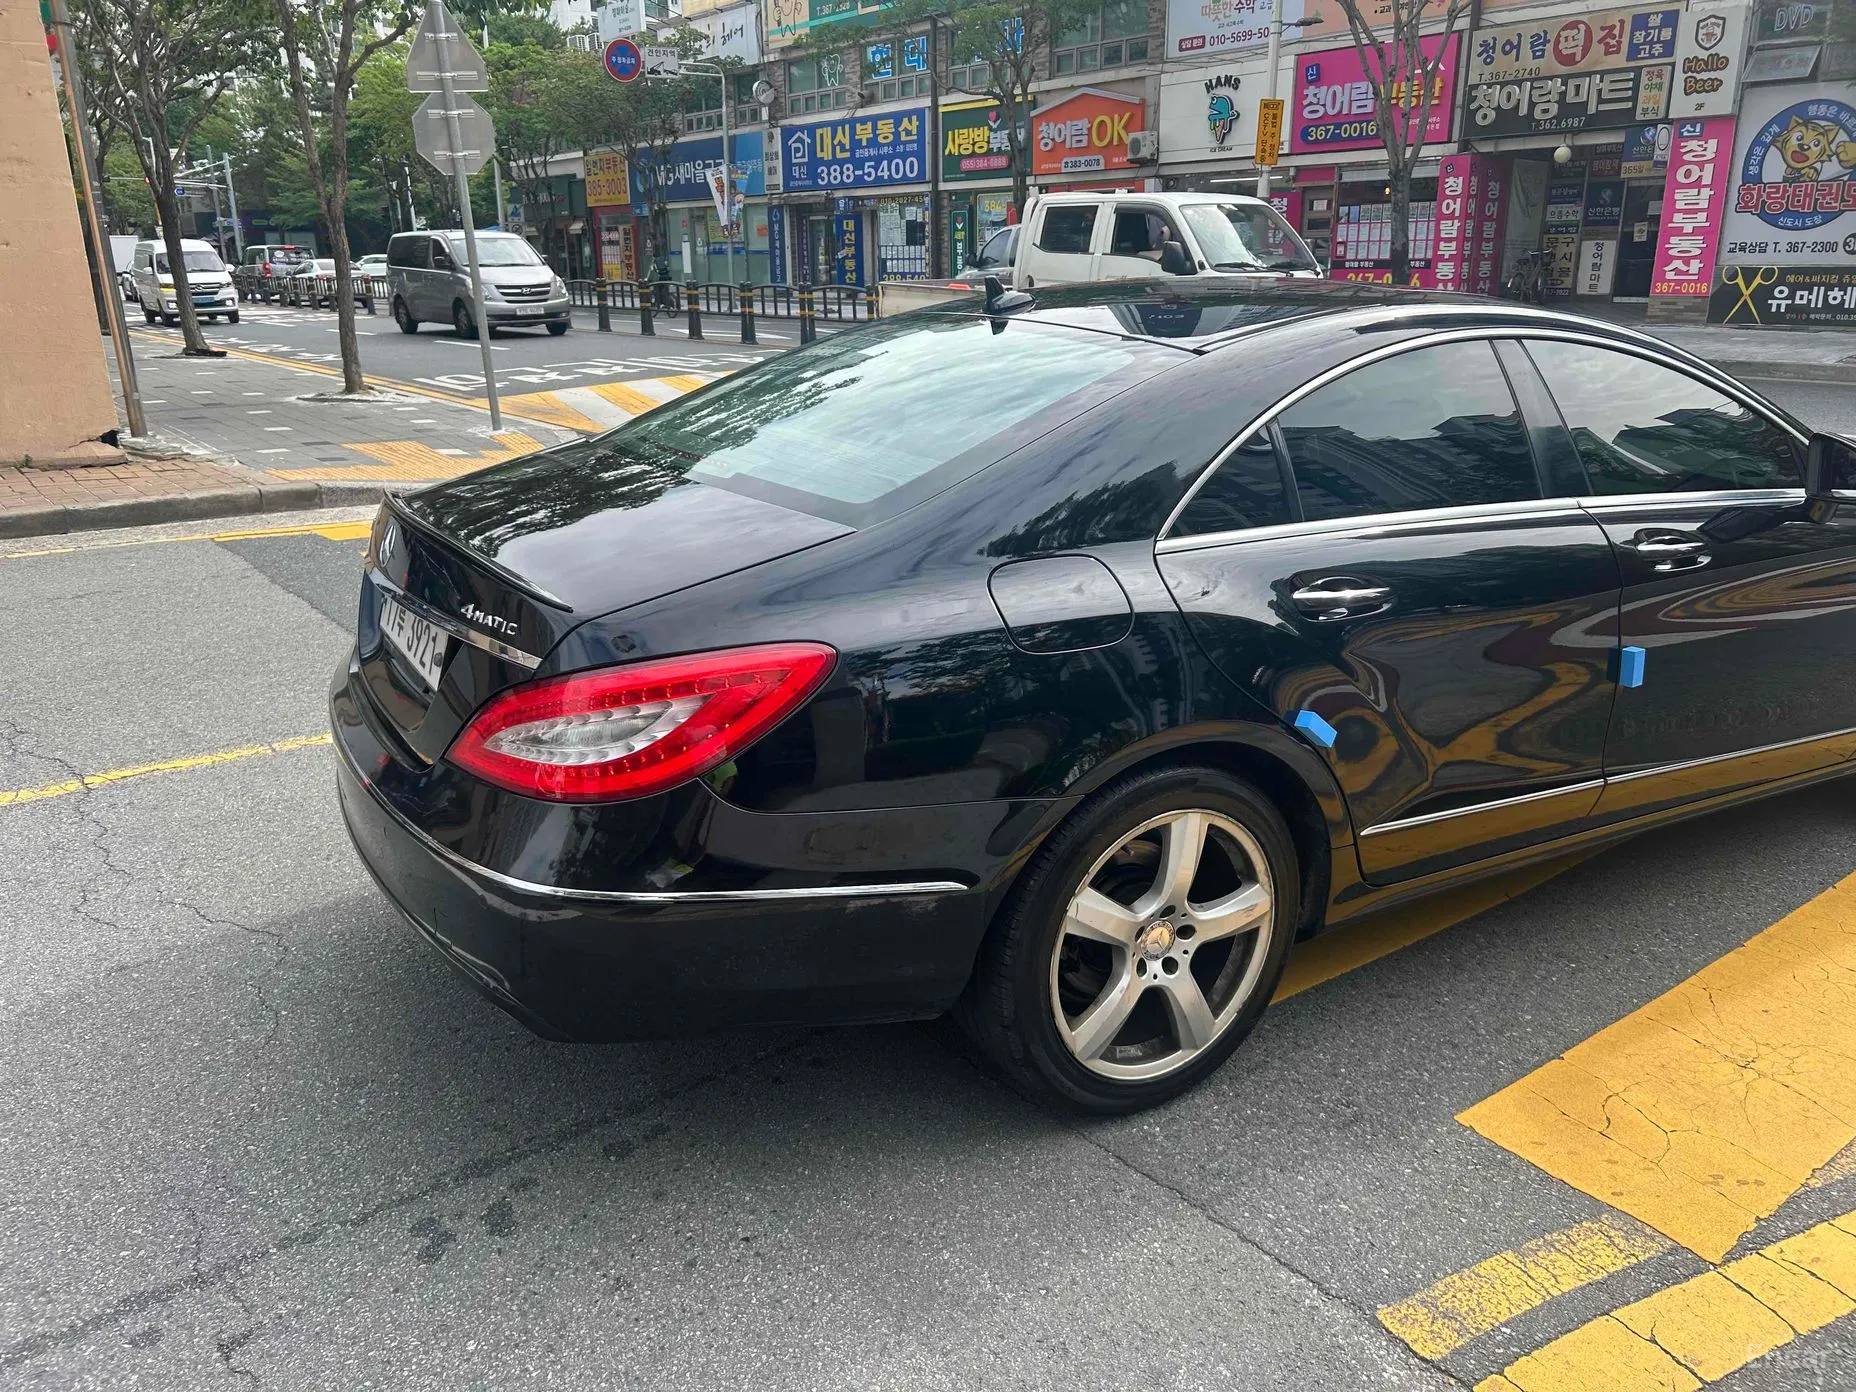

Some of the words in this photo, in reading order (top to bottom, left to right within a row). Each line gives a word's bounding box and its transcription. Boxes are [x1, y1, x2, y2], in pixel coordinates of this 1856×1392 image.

[1234, 0, 1256, 14] 수학
[1647, 13, 1664, 27] 쌀
[1774, 4, 1814, 32] DVD
[1209, 26, 1270, 47] 010-5699-50
[1632, 27, 1673, 43] 참기름
[647, 49, 676, 59] 견인지역
[1637, 44, 1664, 59] 고추
[1682, 52, 1729, 75] Hallo
[1307, 66, 1317, 80] 신
[1478, 66, 1541, 83] T.367-2740
[1645, 68, 1665, 81] 정육
[1204, 74, 1241, 94] HANS
[1643, 81, 1664, 93] 야채
[1683, 76, 1724, 96] Beer
[1302, 81, 1374, 119] 청어람
[1469, 71, 1635, 127] 청어람마트
[1642, 93, 1662, 106] 과일
[1694, 102, 1706, 112] 2F
[1640, 106, 1661, 118] 부식
[1807, 104, 1838, 117] 행동은
[1038, 118, 1091, 152] 청어람
[1091, 111, 1132, 148] OK
[1307, 121, 1377, 142] 367-0016
[1530, 116, 1586, 131] T.362.6987
[1680, 123, 1700, 137] 신
[815, 115, 919, 161] 대신부동산
[944, 126, 1025, 156] 사랑방부동
[1631, 146, 1655, 154] 신한은
[1748, 146, 1765, 176] 생각은
[656, 159, 725, 186] MG새마을
[792, 166, 807, 178] 대신
[817, 157, 918, 185] 388-5400
[1736, 181, 1856, 214] 화랑태권도
[1587, 206, 1620, 216] 신한은행
[1663, 138, 1719, 280] 청어람부동산
[1778, 215, 1802, 228] 신도시
[1805, 214, 1823, 226] 도장
[843, 219, 857, 284] 대신부동산
[1727, 241, 1769, 254] 교육상담
[1772, 241, 1782, 254] T.
[1785, 240, 1839, 254] 367-2300
[1588, 242, 1605, 293] 청어람마트
[1655, 282, 1708, 293] 367-0016
[459, 602, 518, 636] 4MATIC
[406, 616, 439, 676] 3921
